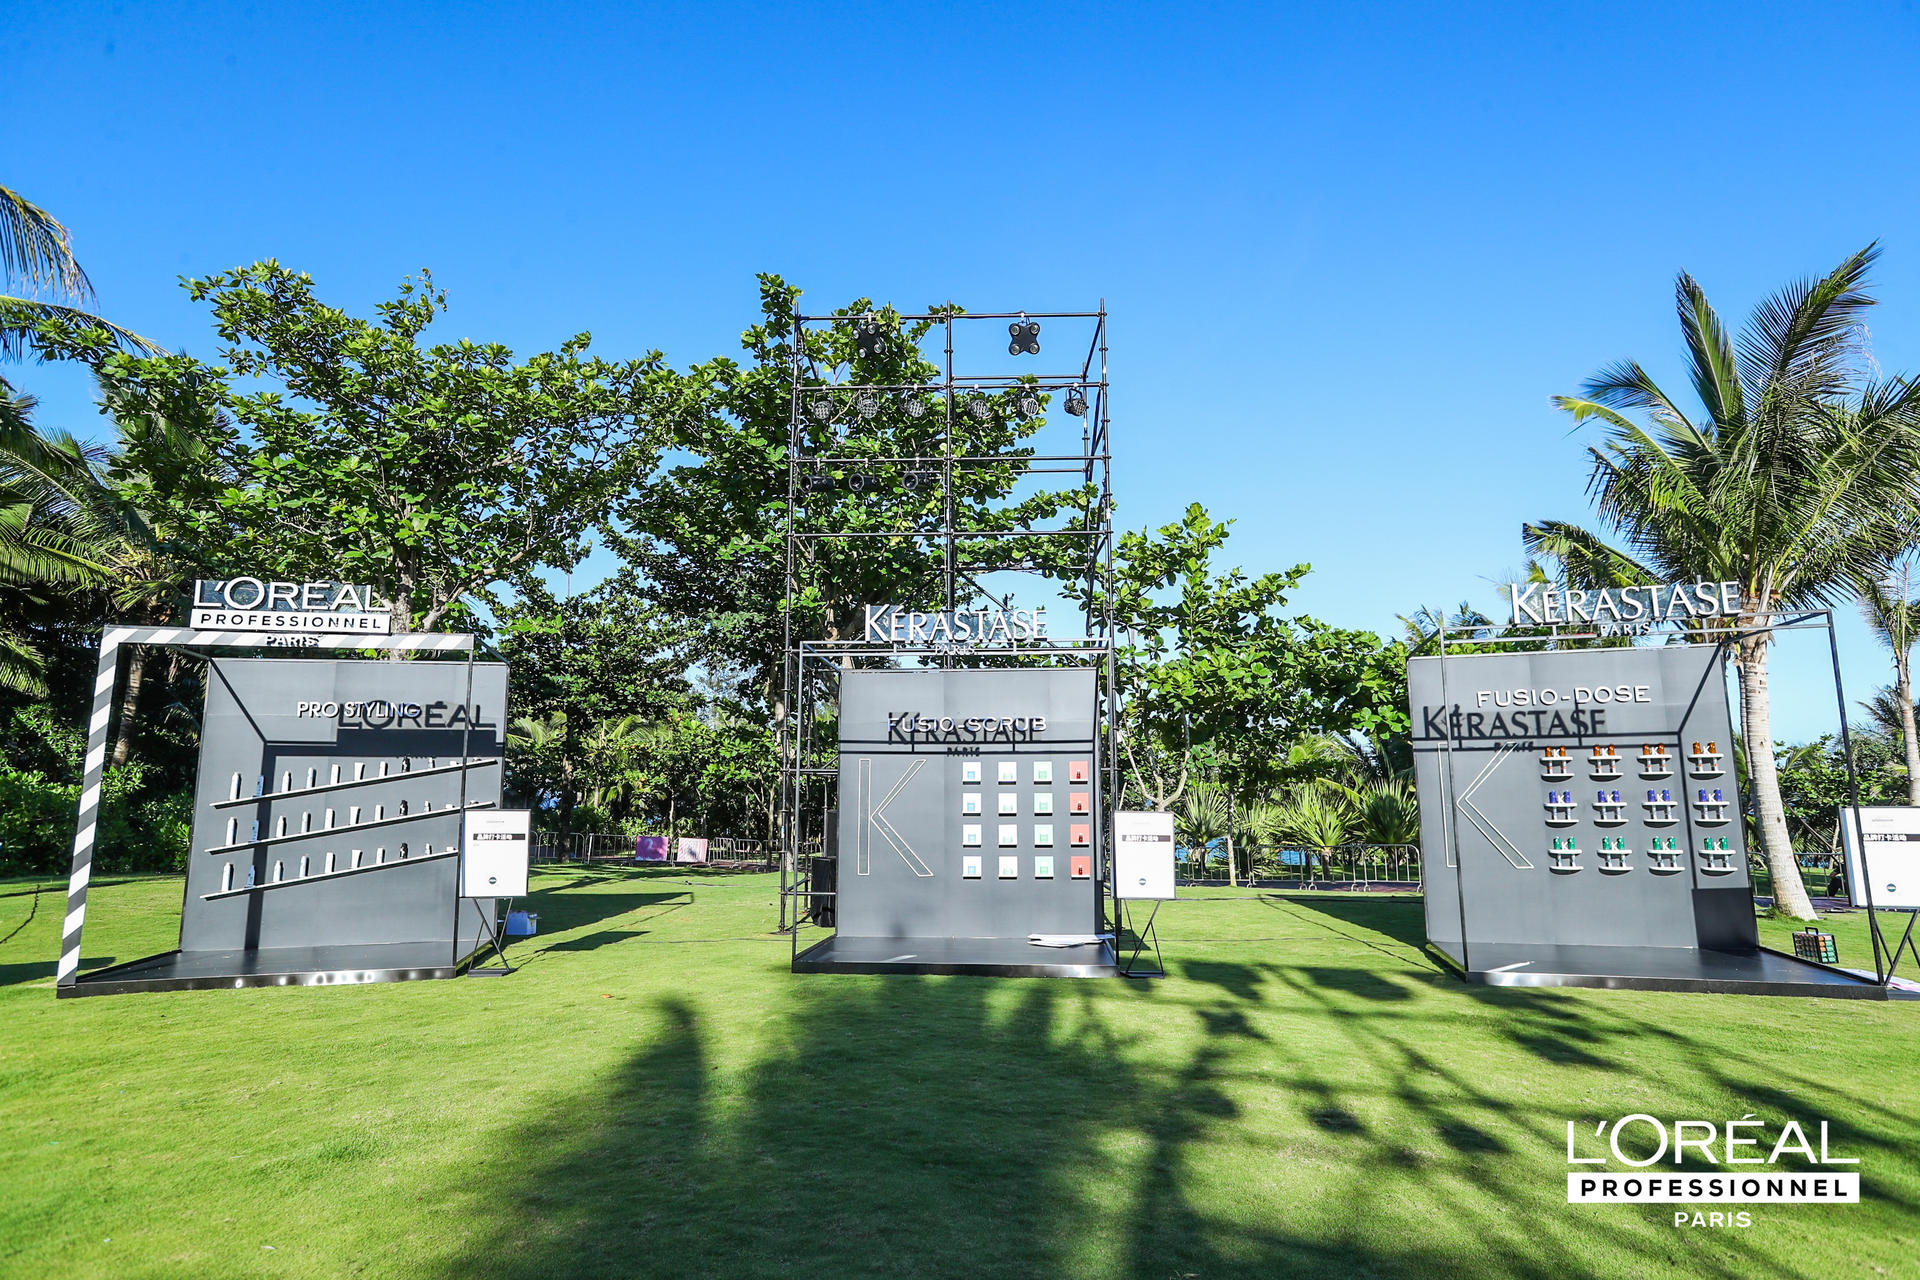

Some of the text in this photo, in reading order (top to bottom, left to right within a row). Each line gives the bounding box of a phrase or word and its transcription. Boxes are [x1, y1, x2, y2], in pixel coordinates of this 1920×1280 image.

[193, 576, 391, 612] L'ORÉAL
[1511, 580, 1744, 625] KÉRASTASE
[200, 613, 382, 629] PROFESSIONNEL
[864, 603, 1048, 643] KÉRASTASE
[1600, 622, 1651, 637] PARIS
[934, 645, 976, 656] PARIS
[1477, 685, 1652, 708] FUSIO-DOSE
[297, 701, 421, 720] PRO STYLING
[888, 716, 1047, 734] FUSIO-SCRUB
